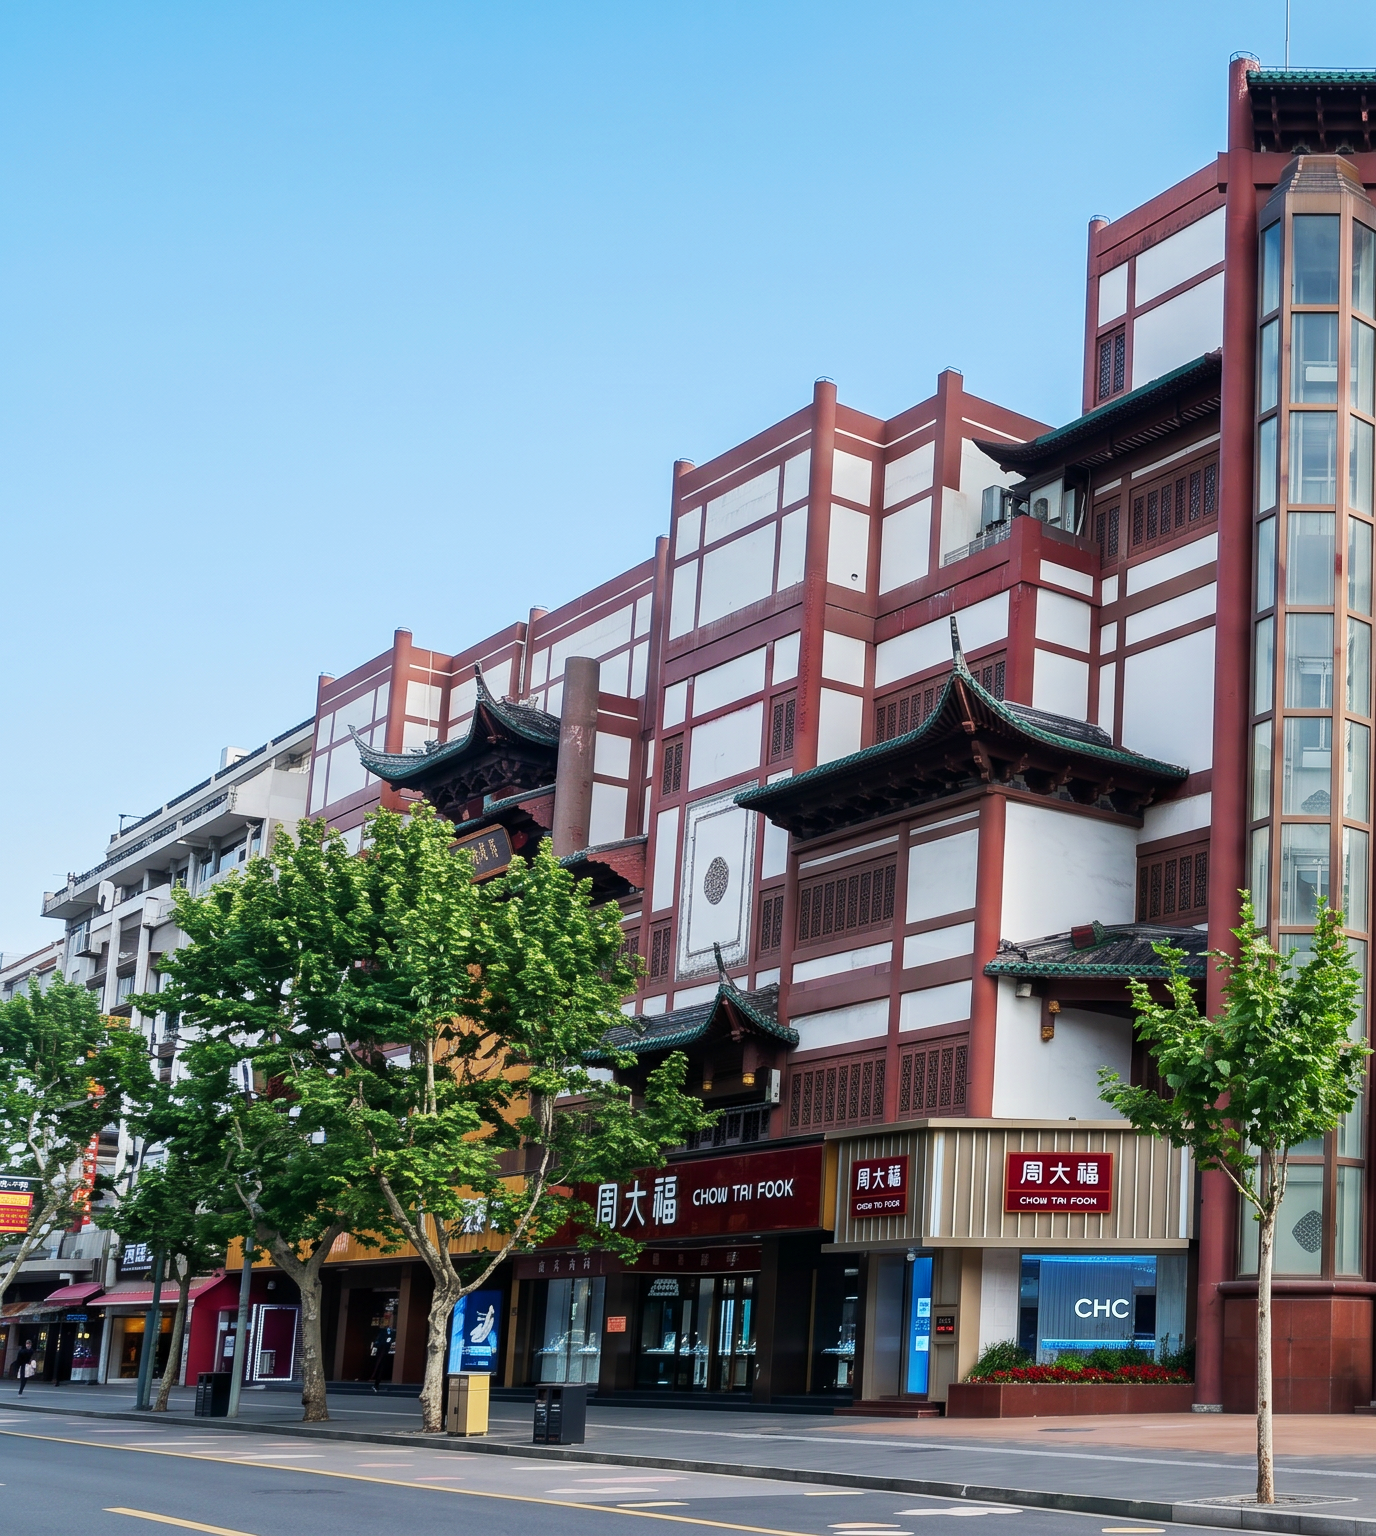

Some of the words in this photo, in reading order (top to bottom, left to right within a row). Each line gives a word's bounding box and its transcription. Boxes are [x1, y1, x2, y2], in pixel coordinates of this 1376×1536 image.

[1020, 1161, 1099, 1185] 周大福
[595, 1175, 678, 1230] 周大福
[692, 1185, 729, 1206] CHOW
[757, 1178, 794, 1199] FOOK
[1019, 1196, 1048, 1205] CHOW
[1074, 1298, 1131, 1319] CHC
